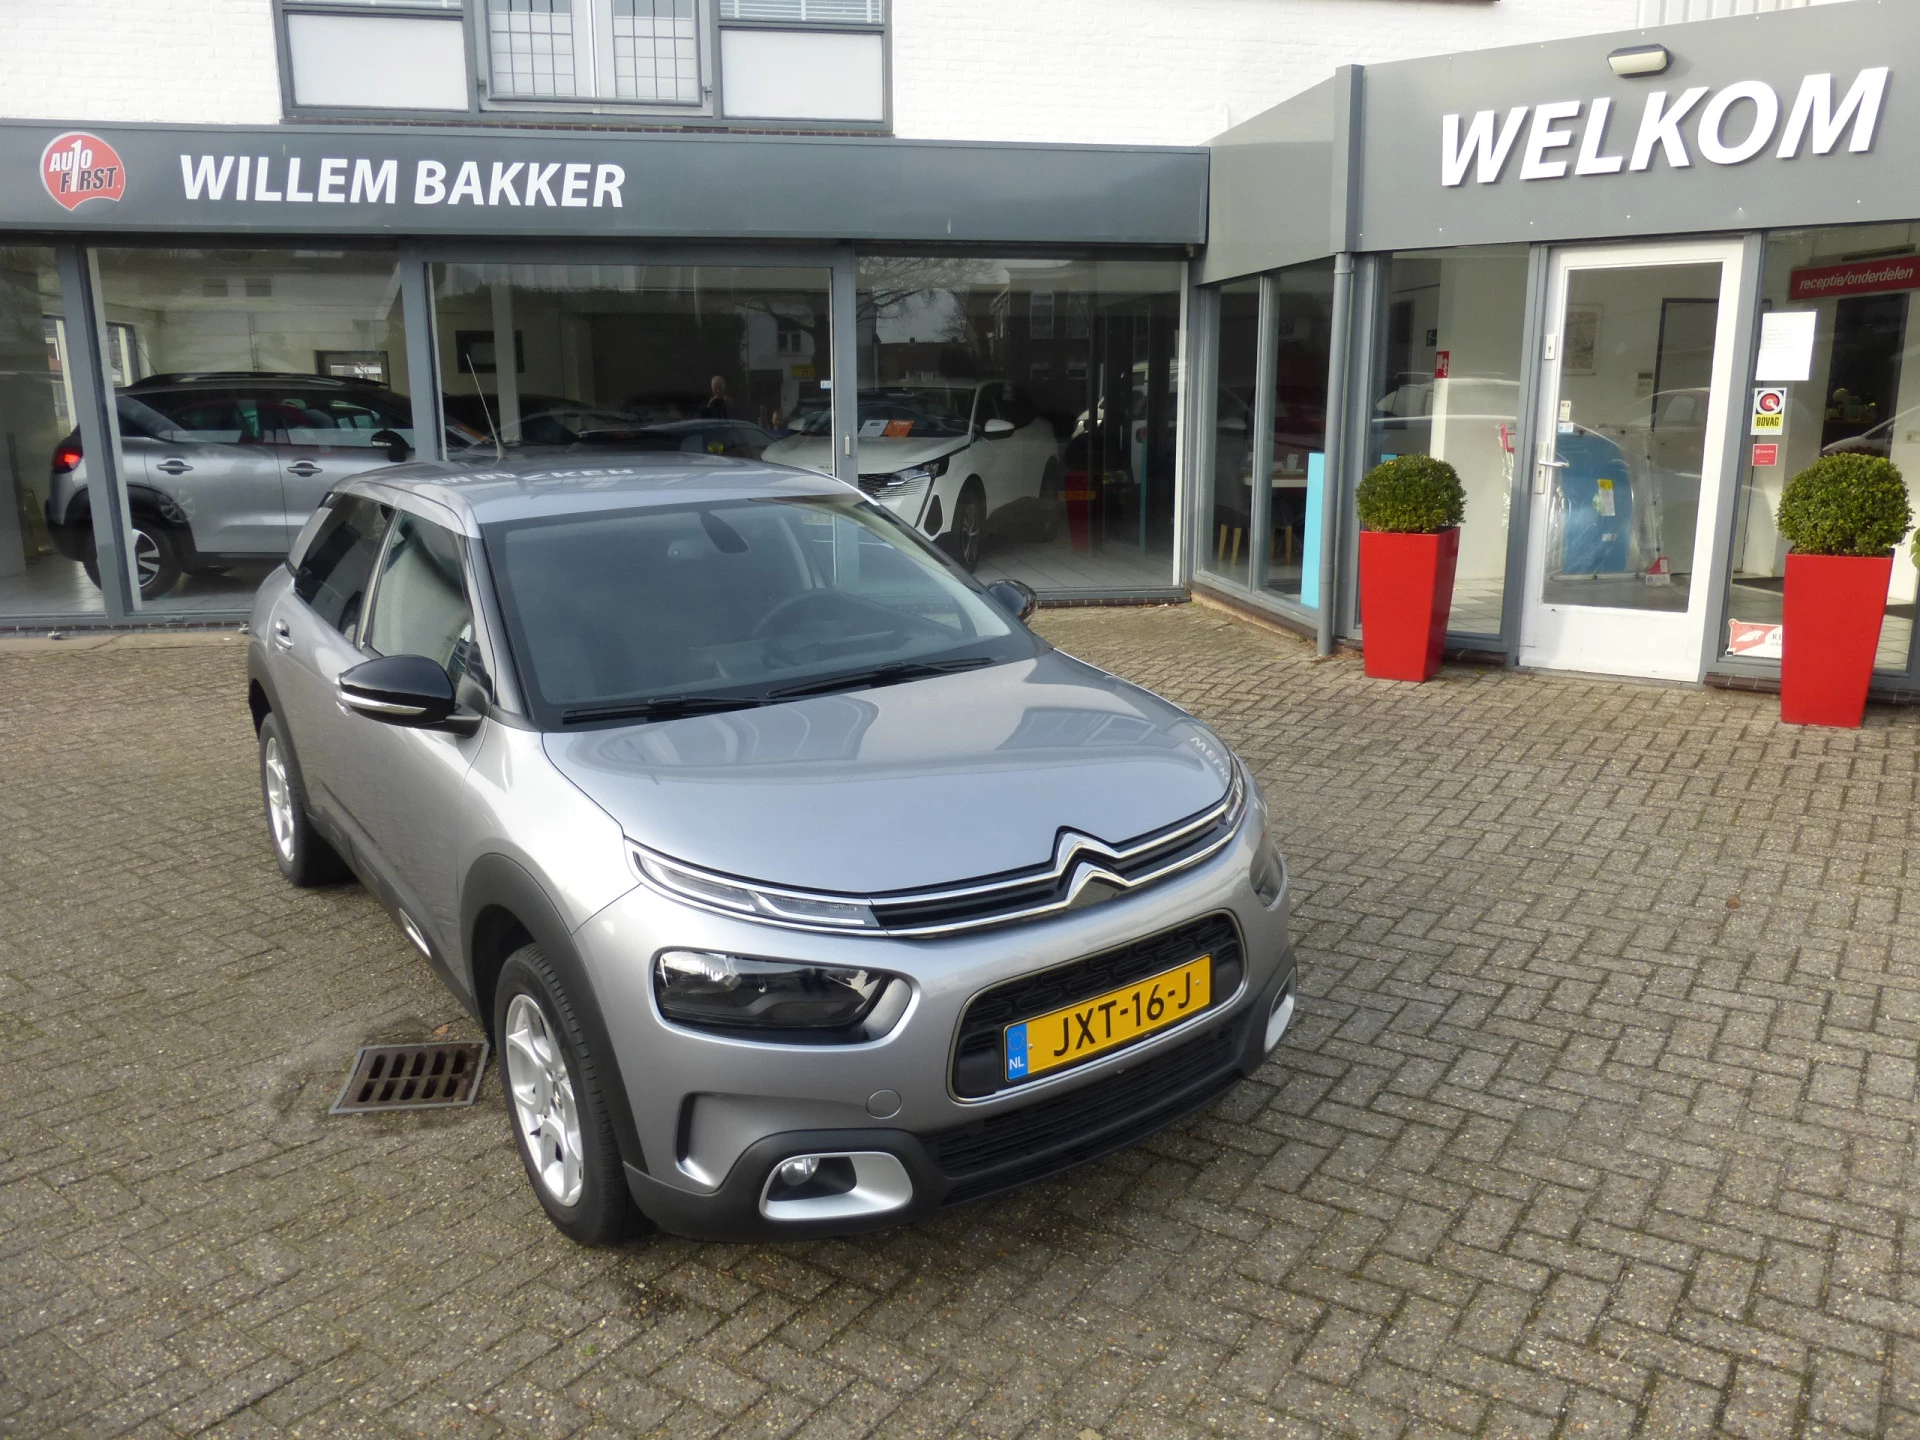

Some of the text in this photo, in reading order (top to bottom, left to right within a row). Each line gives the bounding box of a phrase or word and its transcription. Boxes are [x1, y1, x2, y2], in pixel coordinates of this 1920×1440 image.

[1441, 66, 1889, 187] WELKOM
[180, 154, 627, 208] WILLEM BAKKER
[1798, 266, 1914, 290] receptie/onderdelen
[1756, 417, 1780, 427] BOVAG
[1053, 971, 1191, 1057] JXT-16-J
[1009, 1056, 1025, 1070] NL
